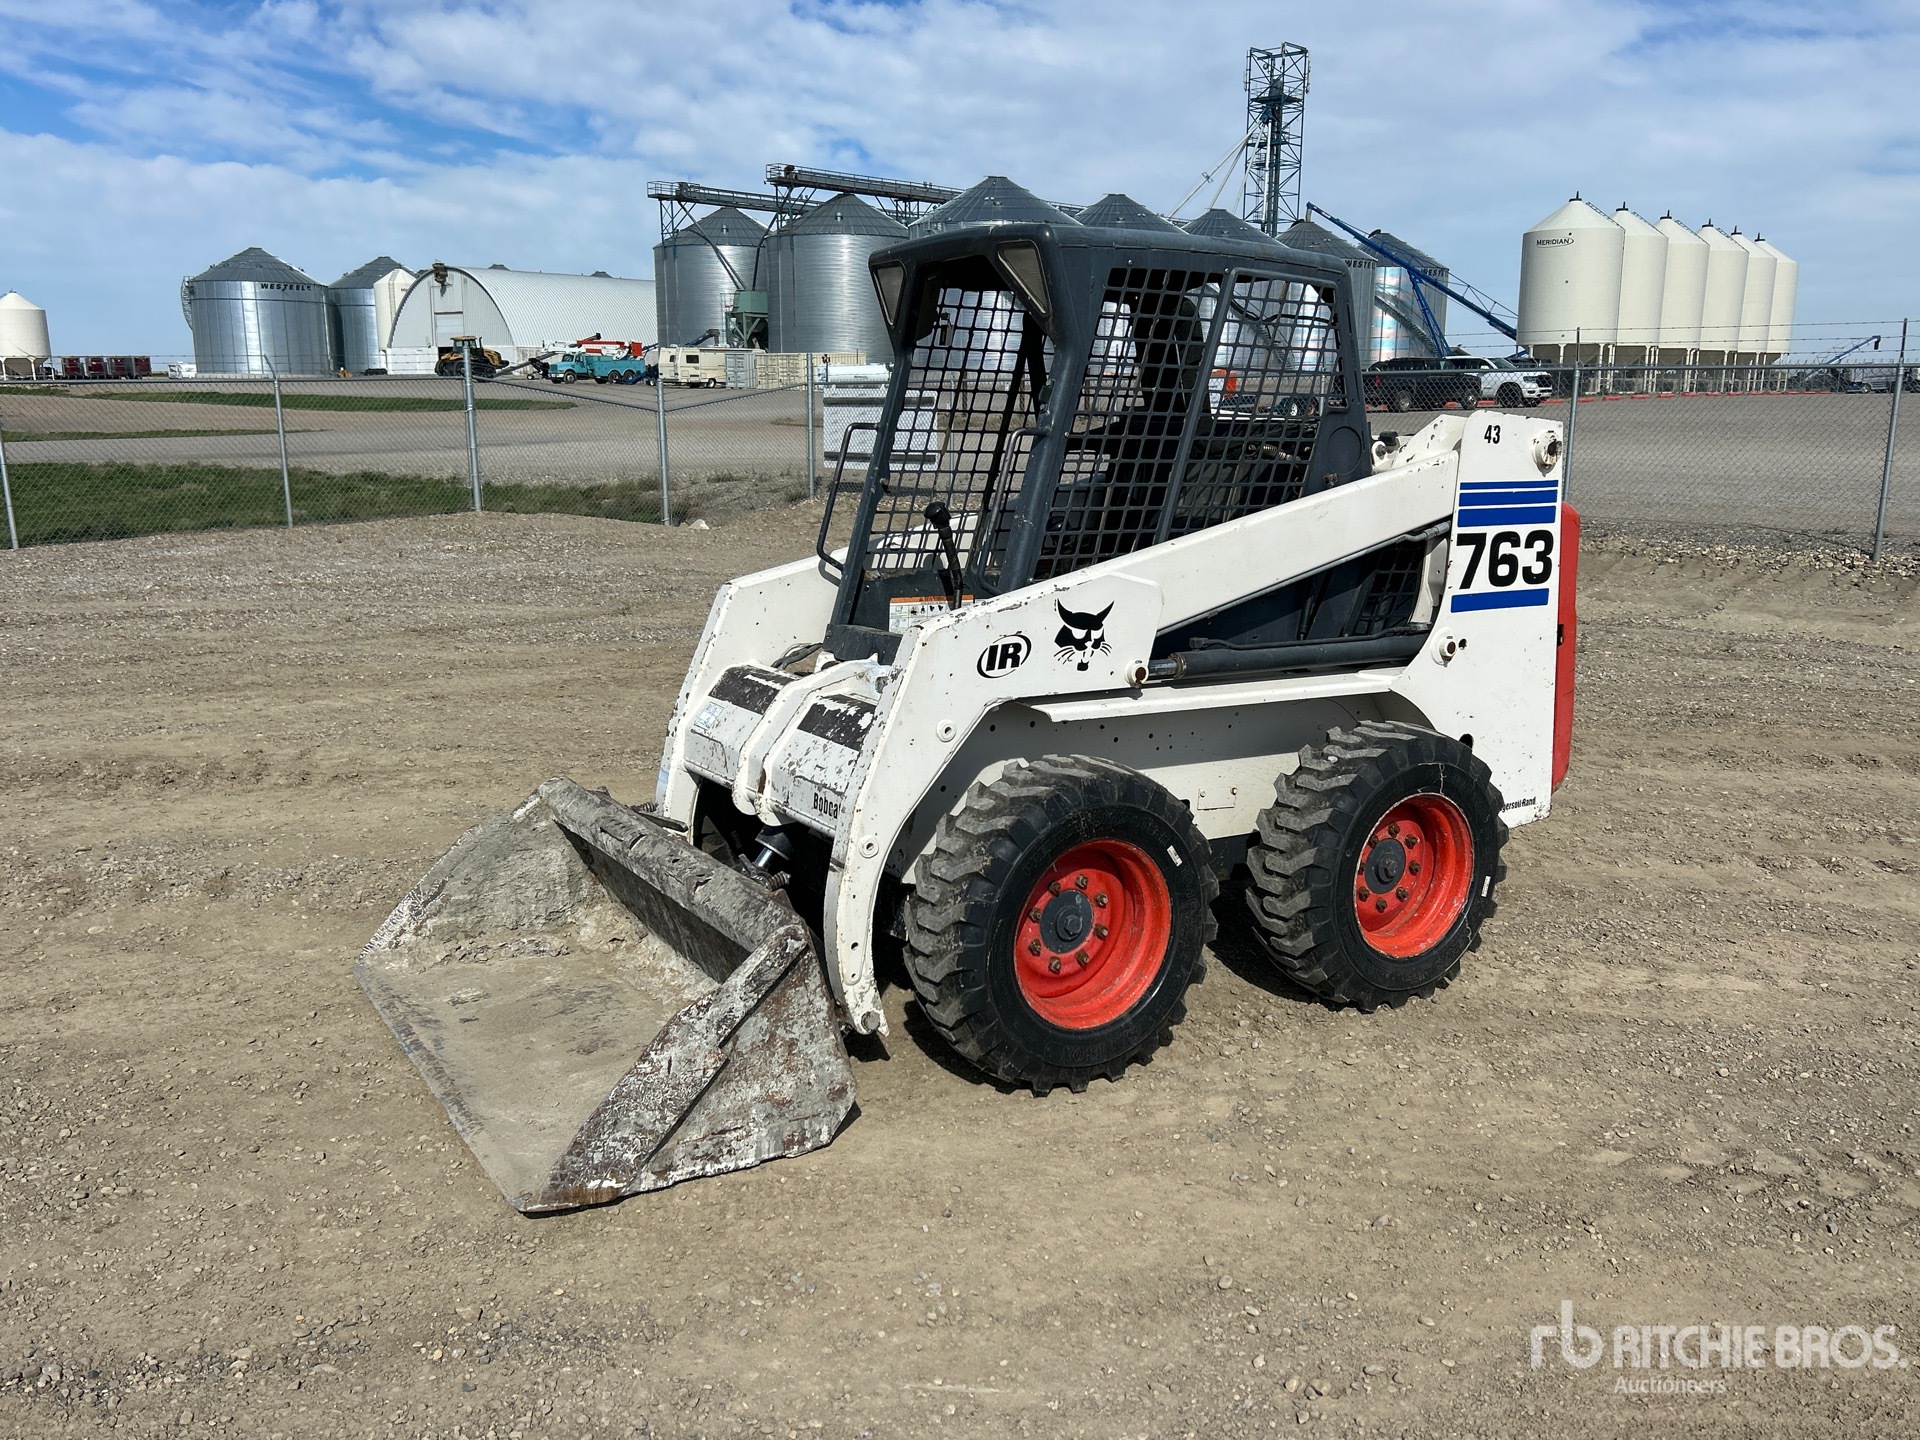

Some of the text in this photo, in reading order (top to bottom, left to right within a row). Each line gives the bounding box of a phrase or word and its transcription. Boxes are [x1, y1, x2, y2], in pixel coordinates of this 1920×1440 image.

[1536, 238, 1570, 246] MERIDIAN
[261, 283, 305, 291] WESTEEL
[1484, 425, 1501, 444] 43
[1457, 529, 1554, 590] 763
[986, 642, 1022, 671] IR
